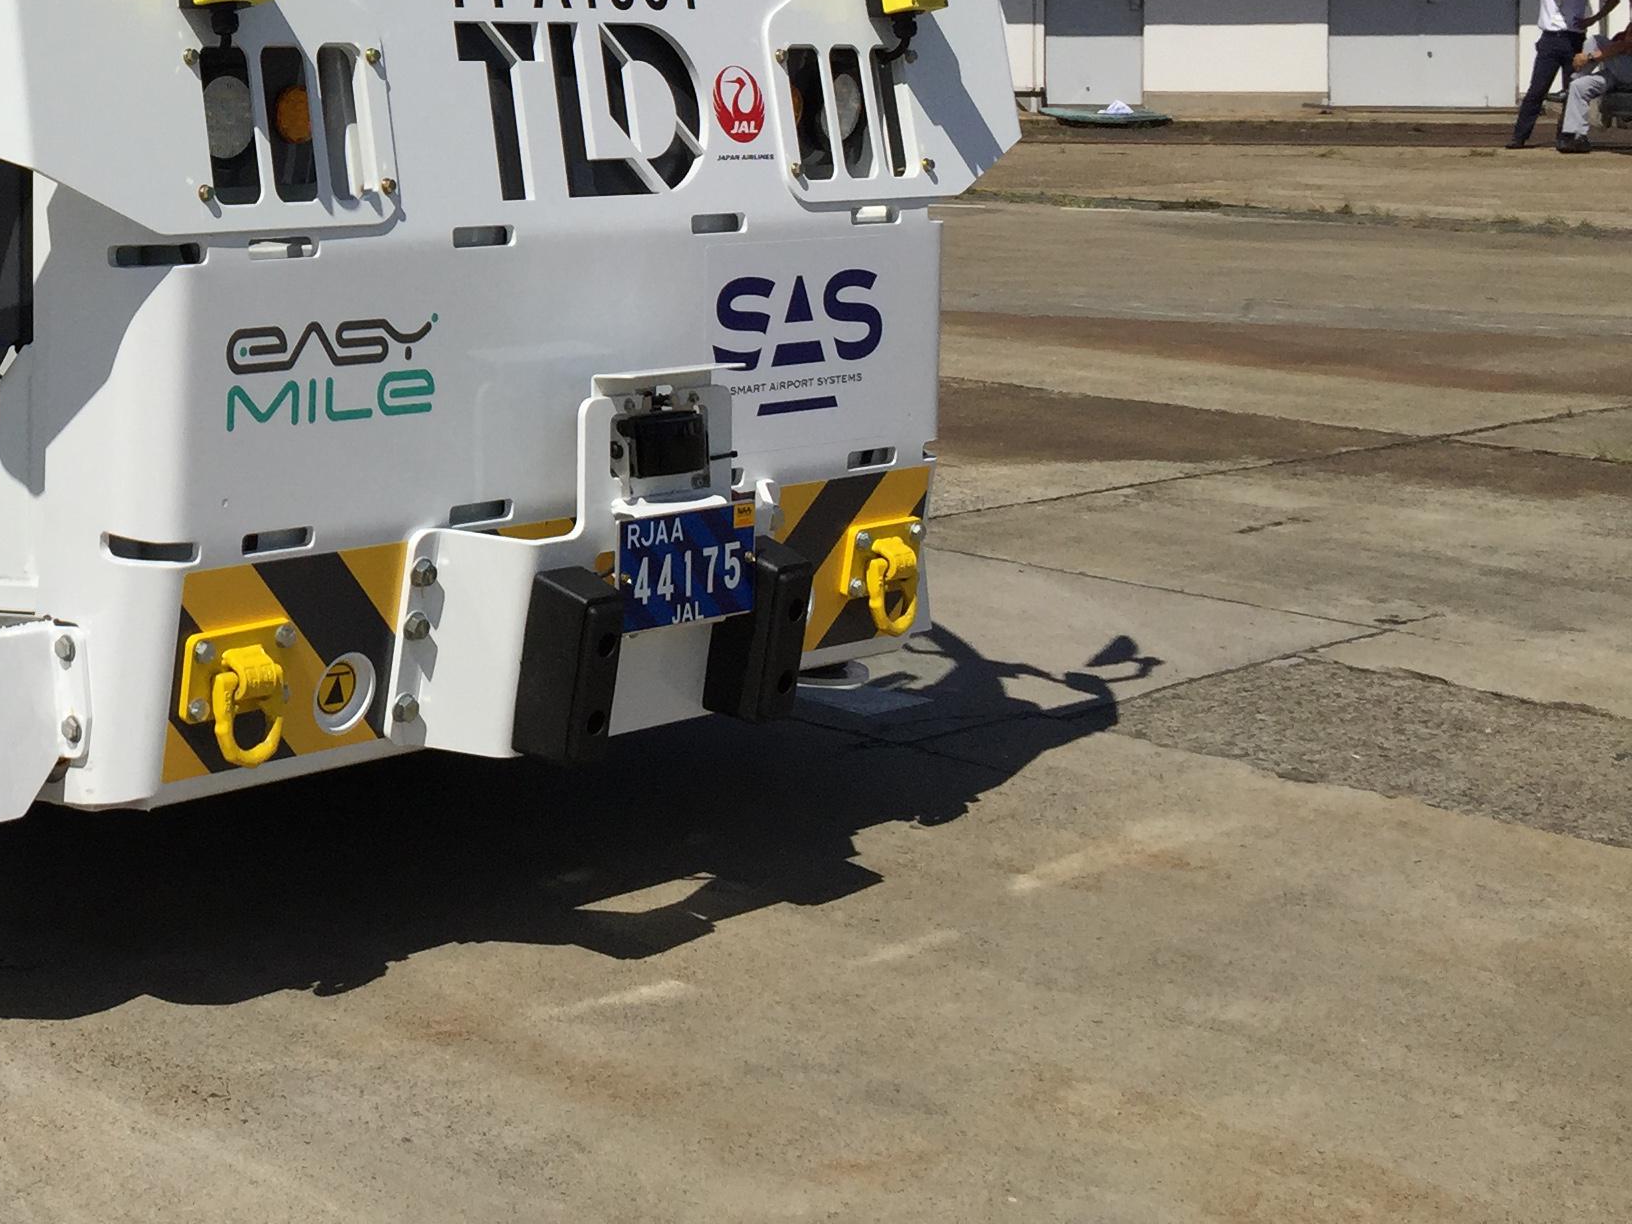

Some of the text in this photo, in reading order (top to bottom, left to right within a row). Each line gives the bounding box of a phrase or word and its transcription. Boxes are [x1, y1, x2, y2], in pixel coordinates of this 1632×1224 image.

[453, 21, 705, 201] TLD
[730, 120, 759, 134] JAL
[717, 153, 775, 162] JAPAN AIRLINES
[712, 268, 883, 372] SAS
[730, 383, 767, 396] SMART
[817, 373, 863, 386] SYSTEMS
[627, 517, 684, 550] RJAA
[634, 541, 741, 605] 44175
[671, 601, 705, 624] JAL
